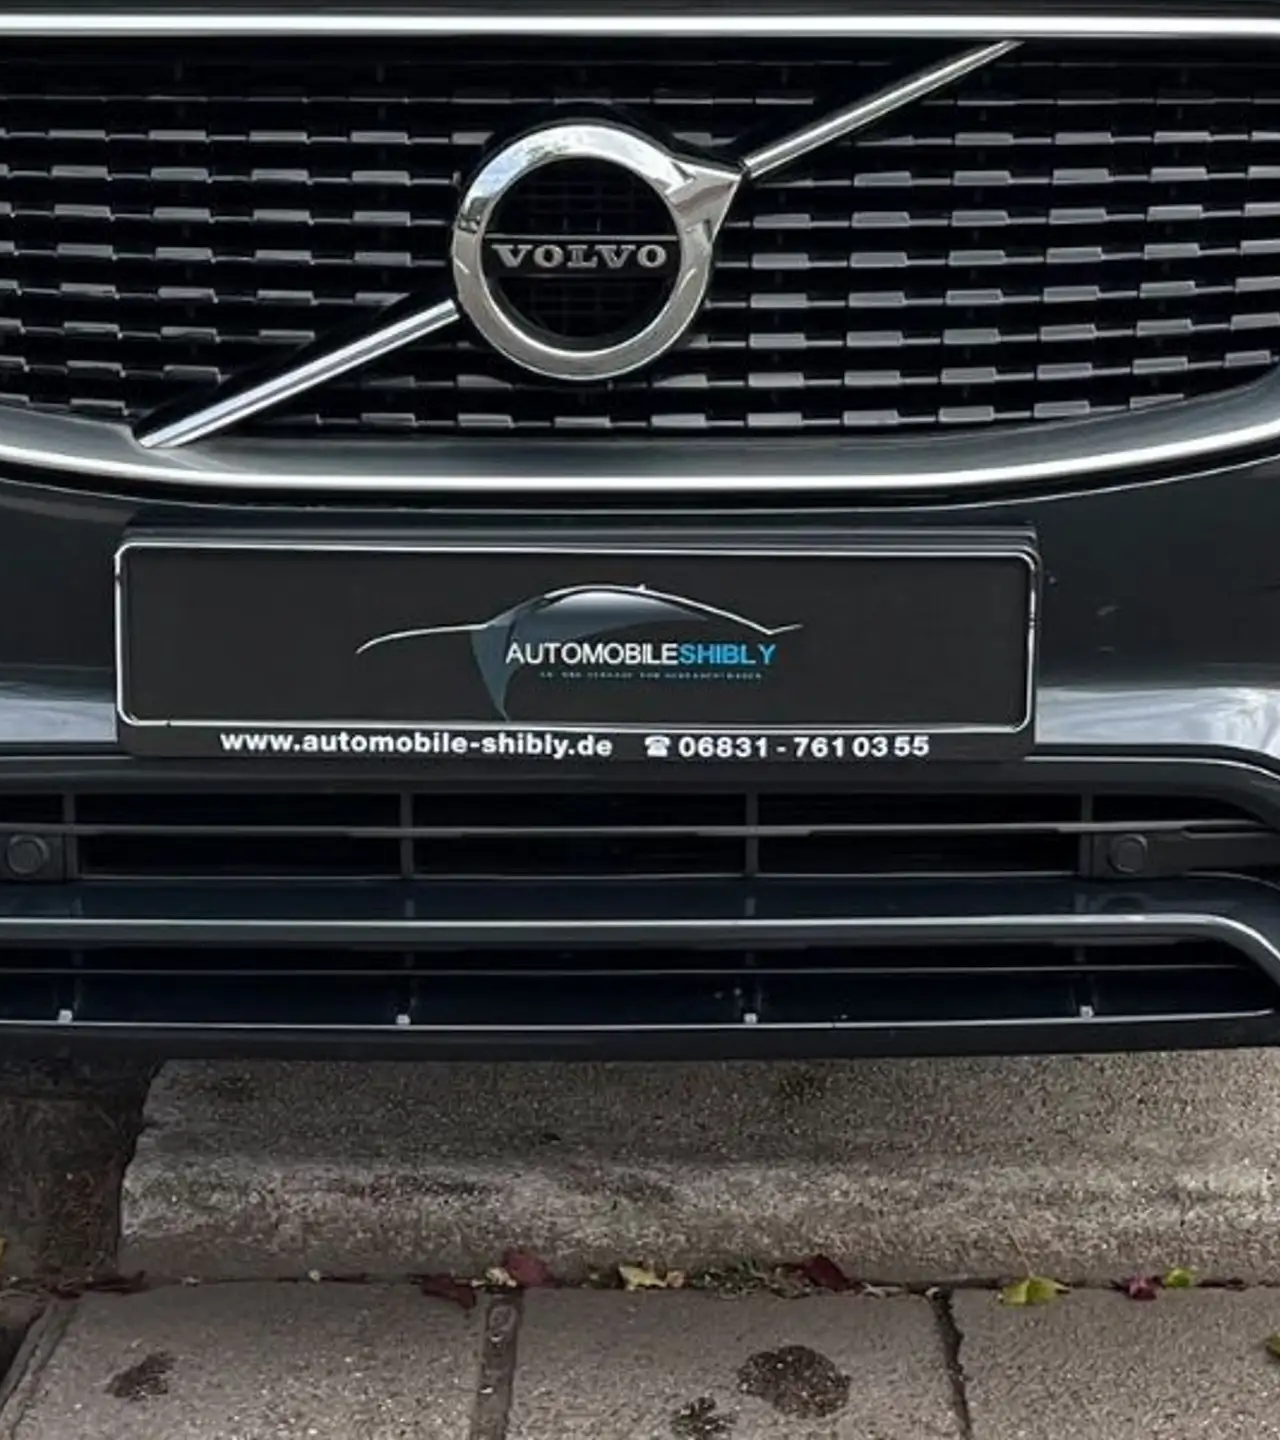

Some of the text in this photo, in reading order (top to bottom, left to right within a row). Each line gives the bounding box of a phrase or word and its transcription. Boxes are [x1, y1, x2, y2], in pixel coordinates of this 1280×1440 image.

[491, 243, 667, 269] VOLVO
[505, 641, 776, 666] AUTOMOBILESHIBLY
[219, 730, 613, 759] www.automobile-shibly.de
[678, 735, 768, 758] 06831
